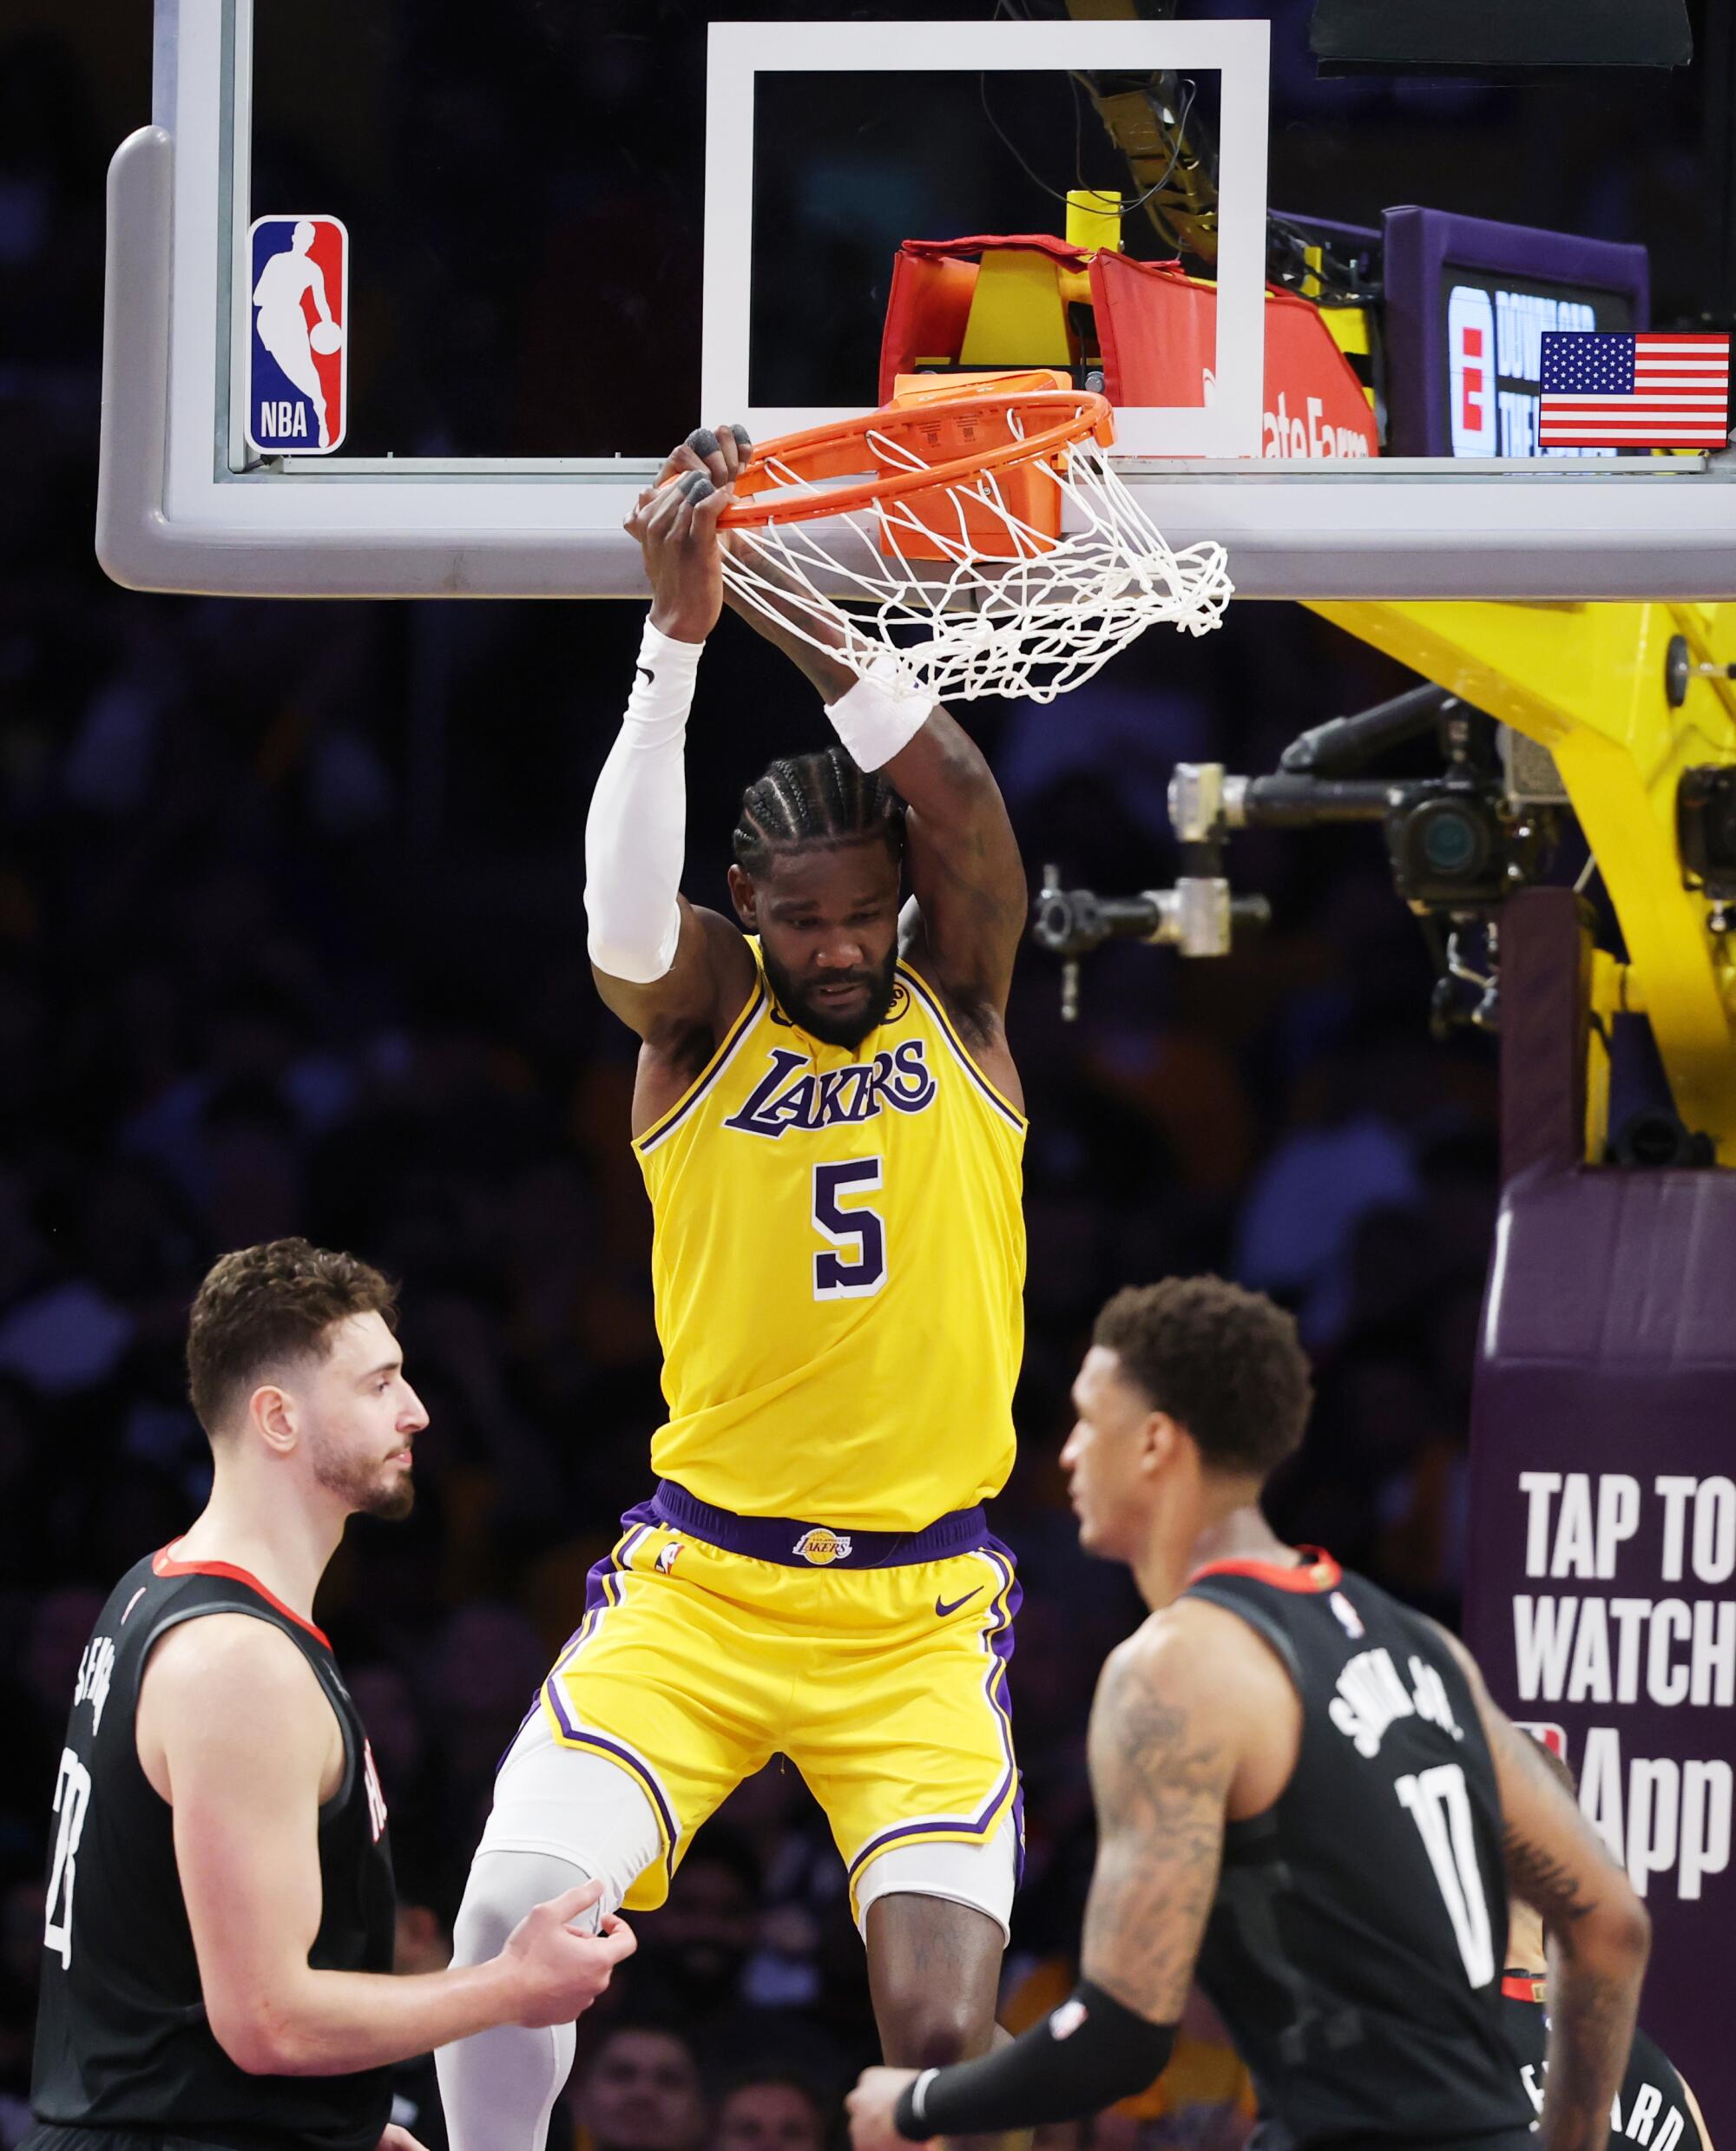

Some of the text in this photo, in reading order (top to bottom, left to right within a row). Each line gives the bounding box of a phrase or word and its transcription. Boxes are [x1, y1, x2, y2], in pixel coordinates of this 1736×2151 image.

[261, 401, 308, 437] NBA
[812, 1154, 889, 1301] 5
[792, 1536, 852, 1558] LAKERS
[1519, 1472, 1736, 1584] TAP TO
[1513, 1595, 1736, 1707] WATCH
[1578, 1727, 1733, 1901] App
